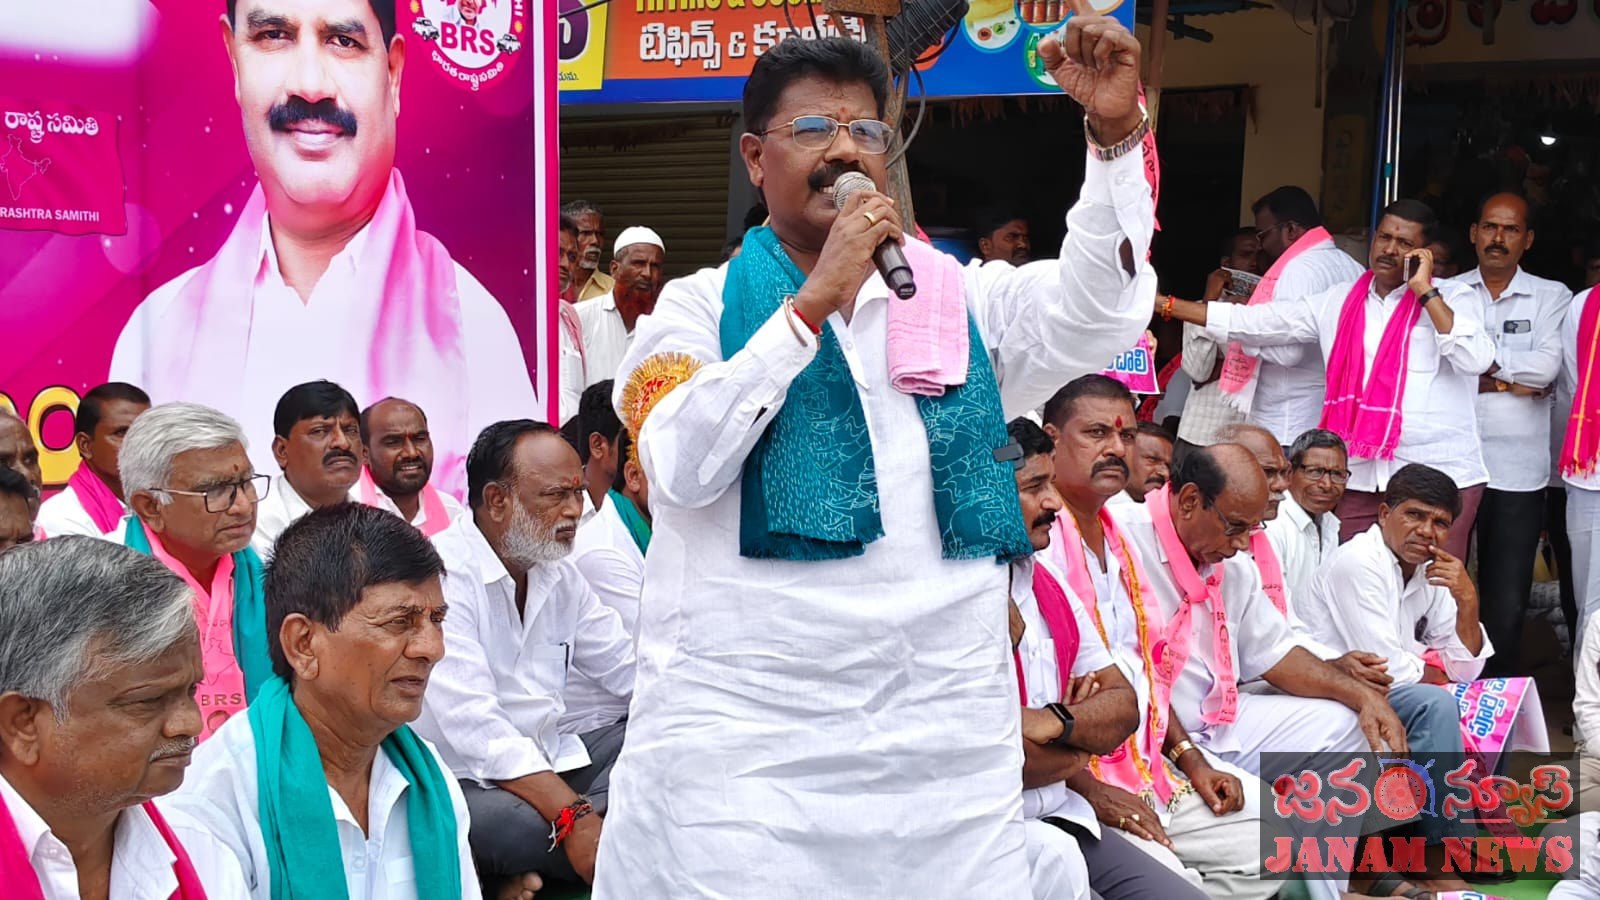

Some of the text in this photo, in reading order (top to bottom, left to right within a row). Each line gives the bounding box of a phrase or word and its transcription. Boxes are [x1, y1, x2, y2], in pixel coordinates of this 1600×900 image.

[440, 21, 495, 56] BRS
[728, 31, 747, 57] &
[4, 111, 99, 143] రాష్ట్ర సమితి
[0, 206, 100, 222] RASHTRA SAMITHI
[201, 692, 242, 706] BRS
